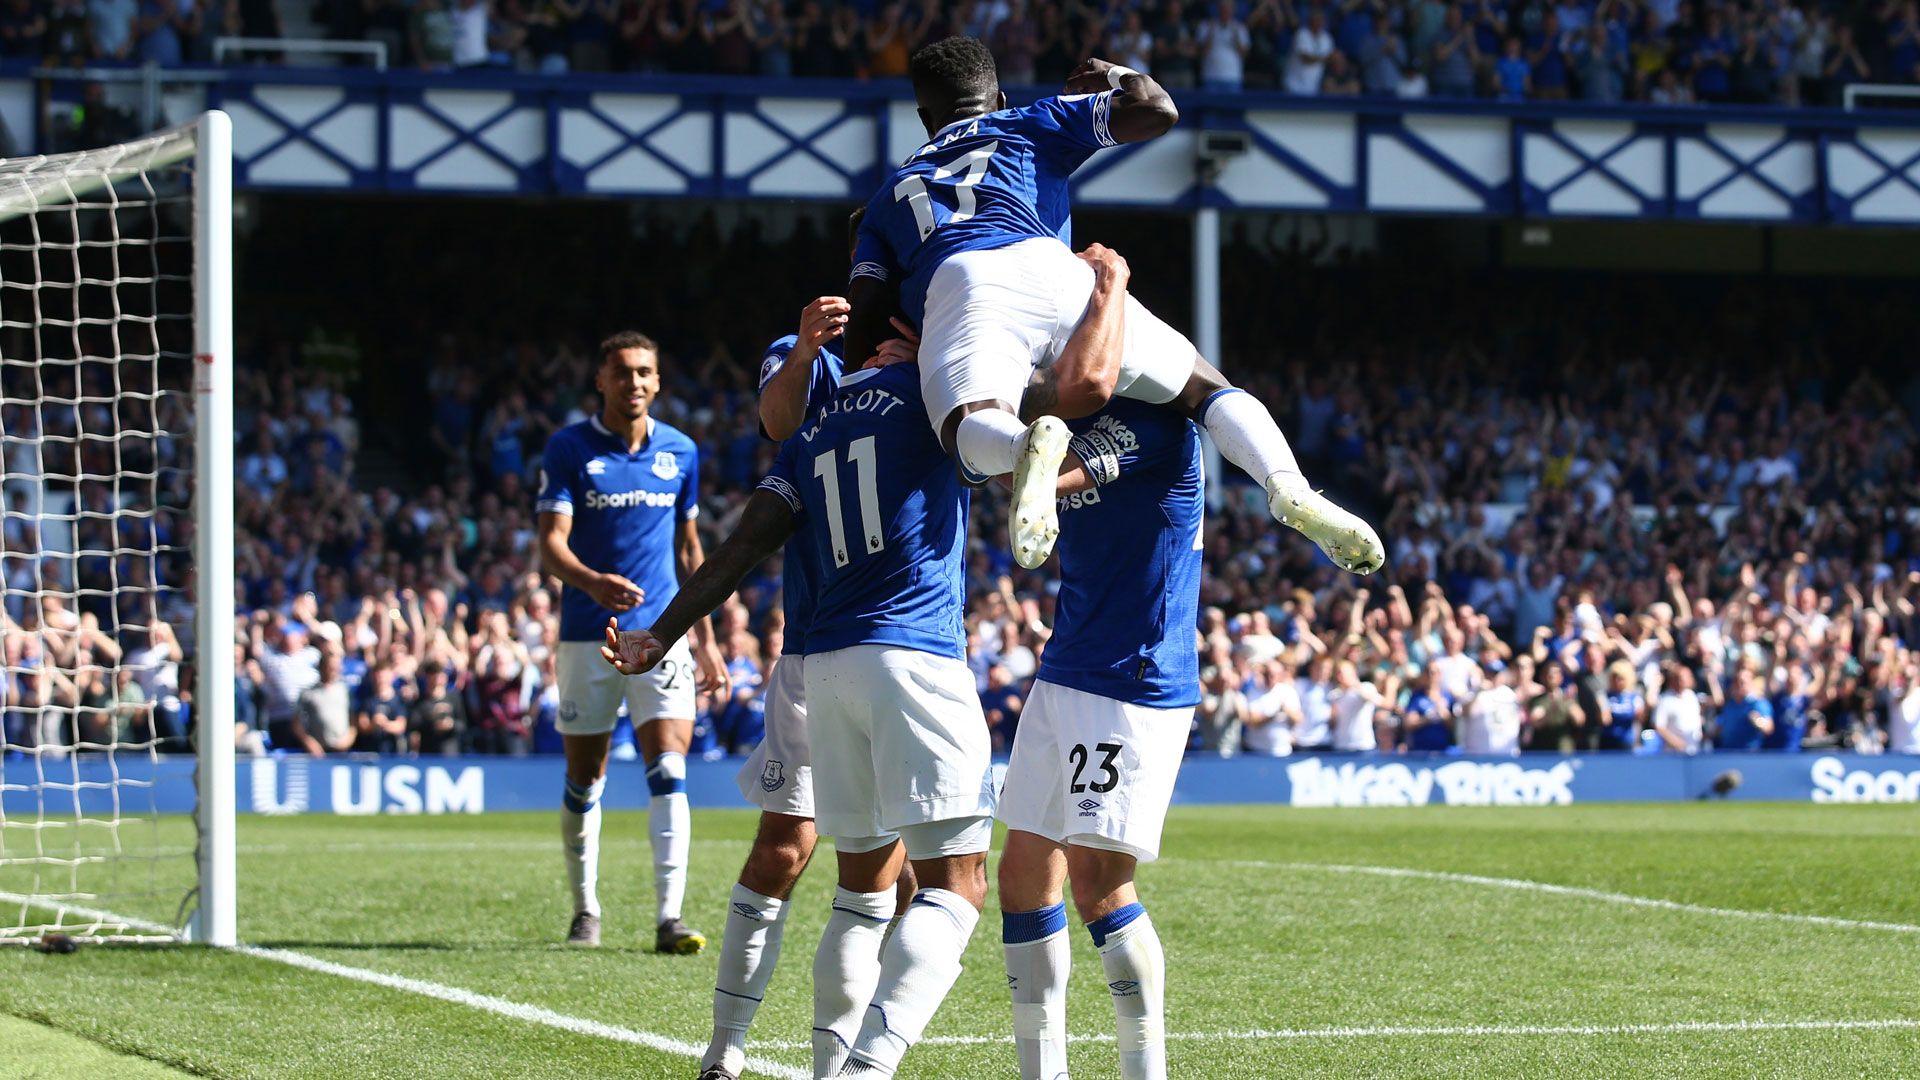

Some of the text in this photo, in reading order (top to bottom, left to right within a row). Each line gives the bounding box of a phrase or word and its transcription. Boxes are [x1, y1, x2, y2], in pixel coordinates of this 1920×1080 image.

[894, 140, 998, 243] 17
[585, 489, 677, 510] SportPesa
[814, 435, 885, 569] 11
[331, 765, 484, 815] USM
[1069, 743, 1123, 794] 23
[1286, 757, 1574, 807] ANGRY BIRDS
